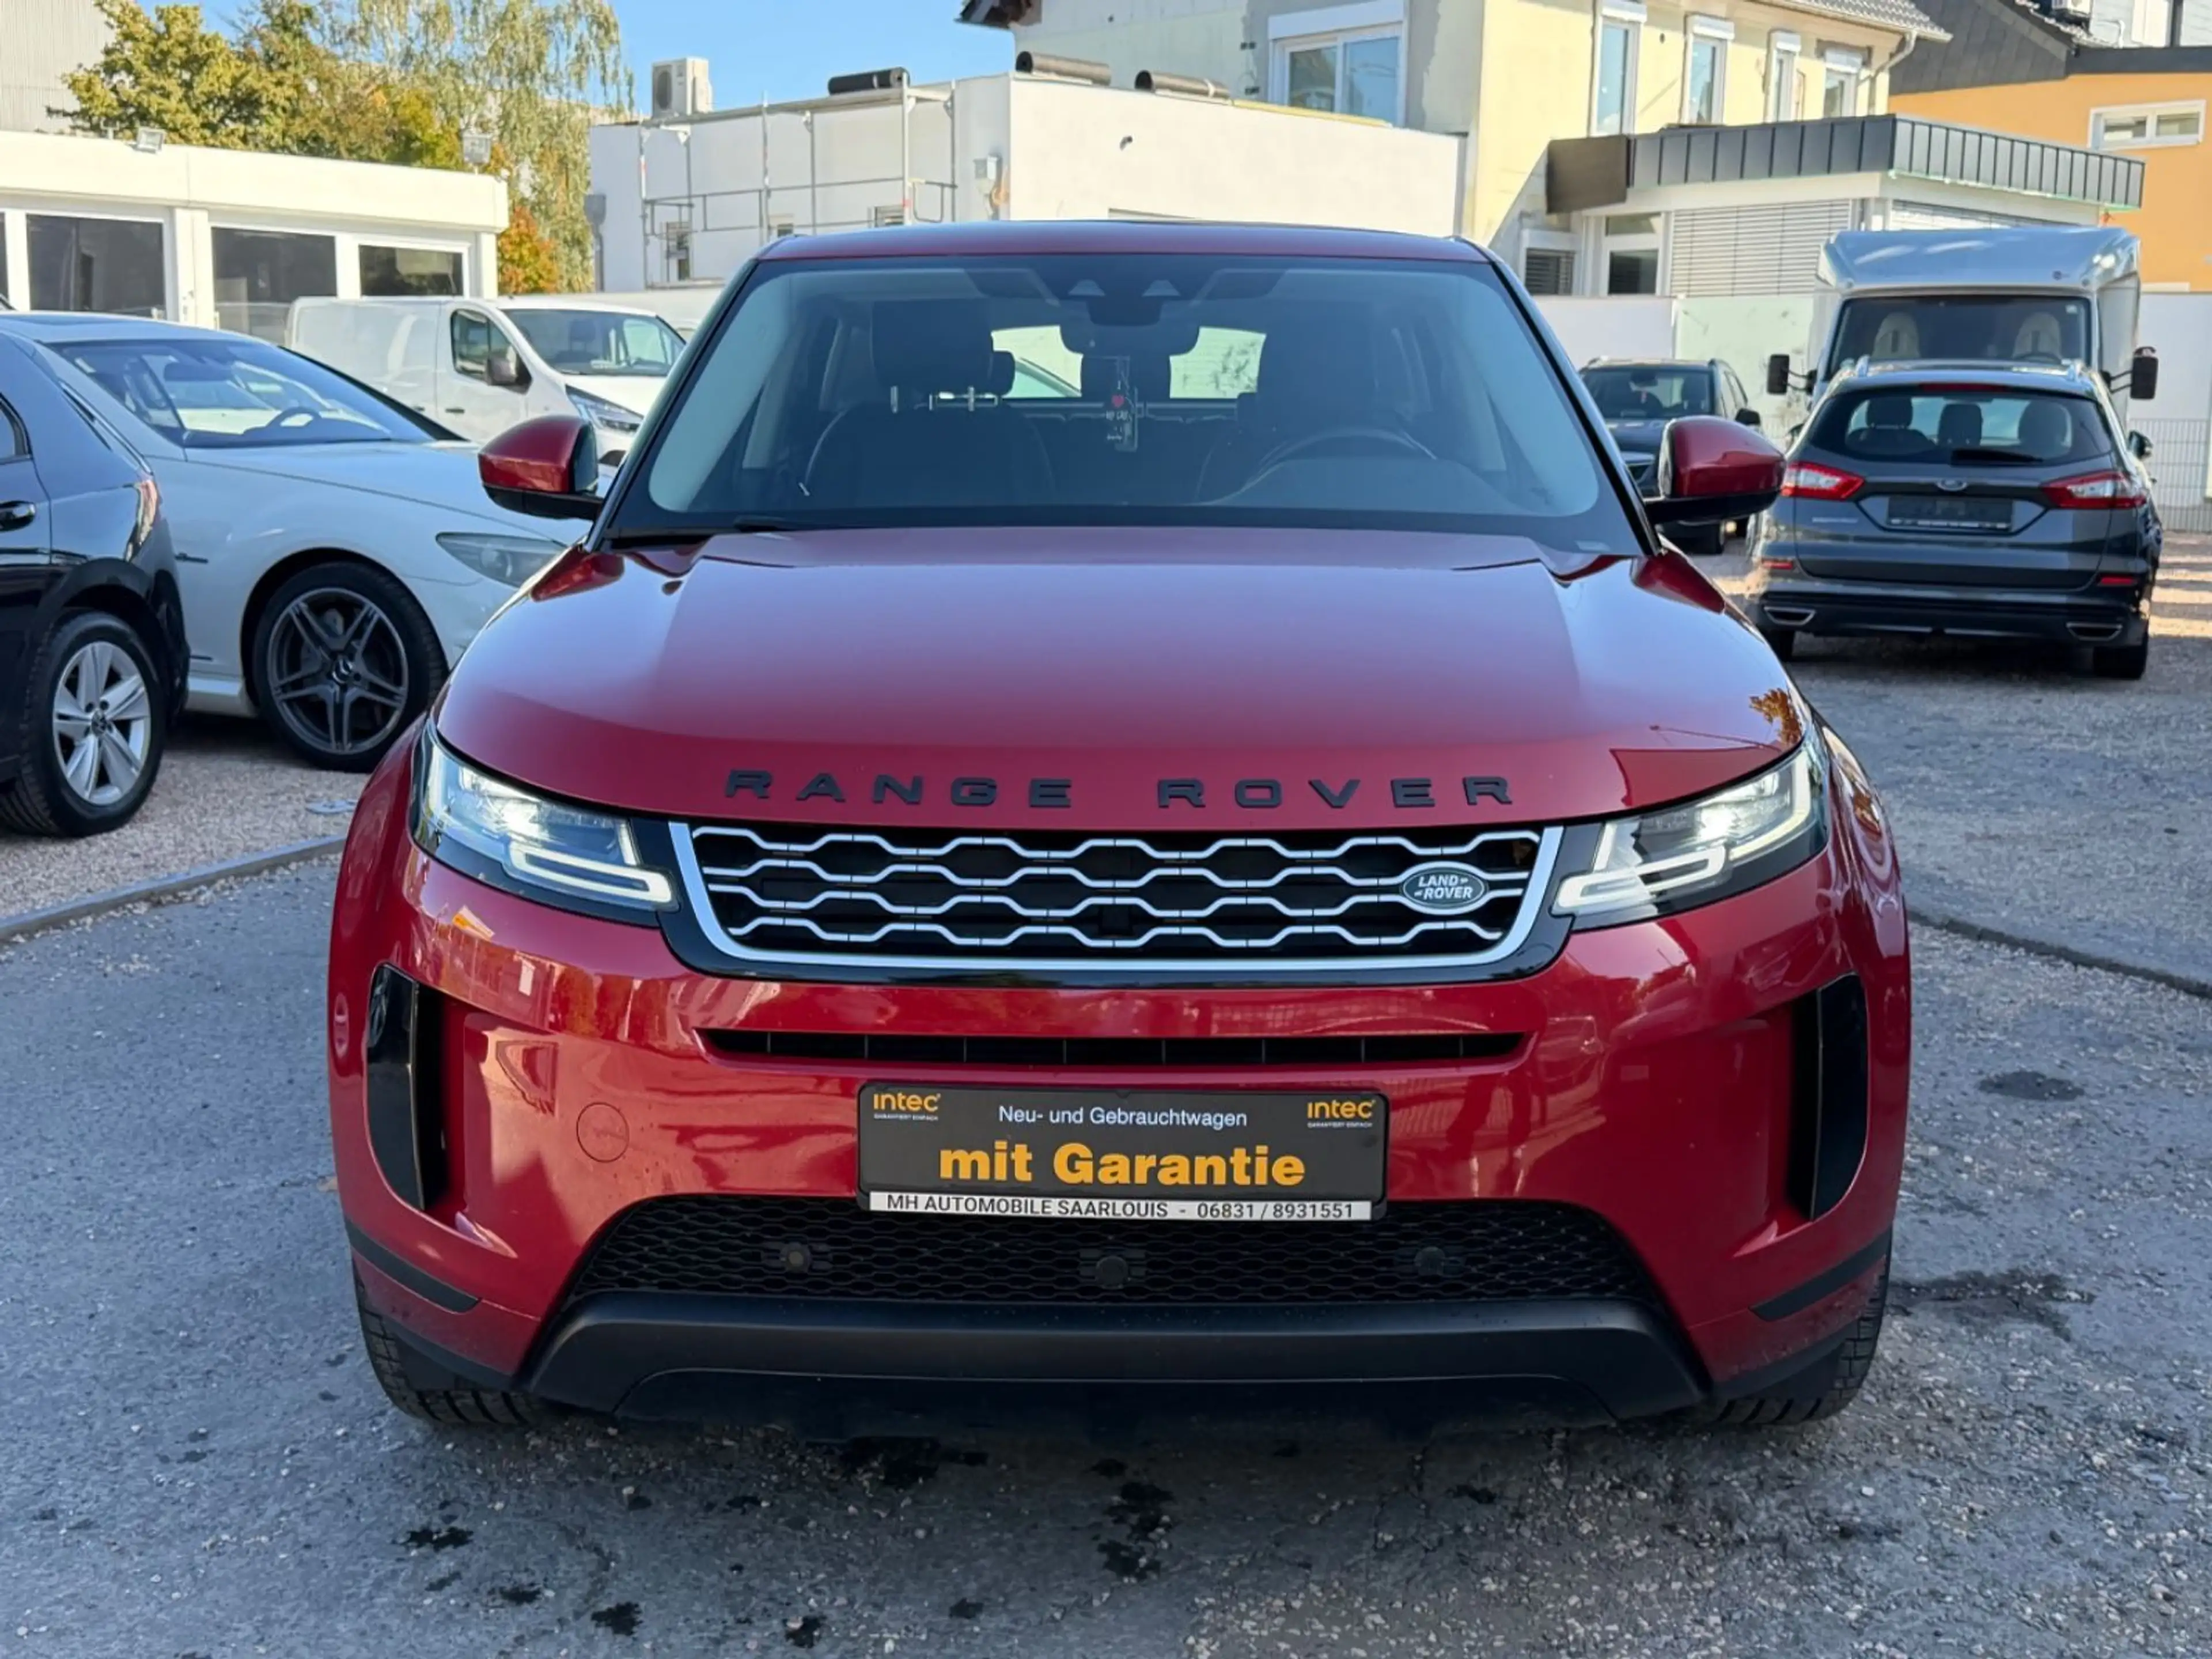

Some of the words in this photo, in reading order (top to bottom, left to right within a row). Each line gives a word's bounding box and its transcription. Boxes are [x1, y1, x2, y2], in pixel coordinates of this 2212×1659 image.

[725, 769, 1071, 808] RANGE
[1157, 777, 1513, 808] ROVER
[1418, 874, 1459, 888] LAND
[1423, 886, 1474, 900] ROVER
[999, 1105, 1043, 1123] Neu-
[1050, 1107, 1084, 1124] und
[1090, 1107, 1247, 1130] Gebrauchtwagen
[939, 1140, 1033, 1182] mit
[1053, 1142, 1306, 1186] Garantie
[887, 1194, 918, 1210] MH
[924, 1196, 1052, 1215] AUTOMOBILE
[1057, 1200, 1168, 1217] SAARLOUIS
[1197, 1202, 1254, 1218] 06831
[1272, 1203, 1353, 1218] 8931551
